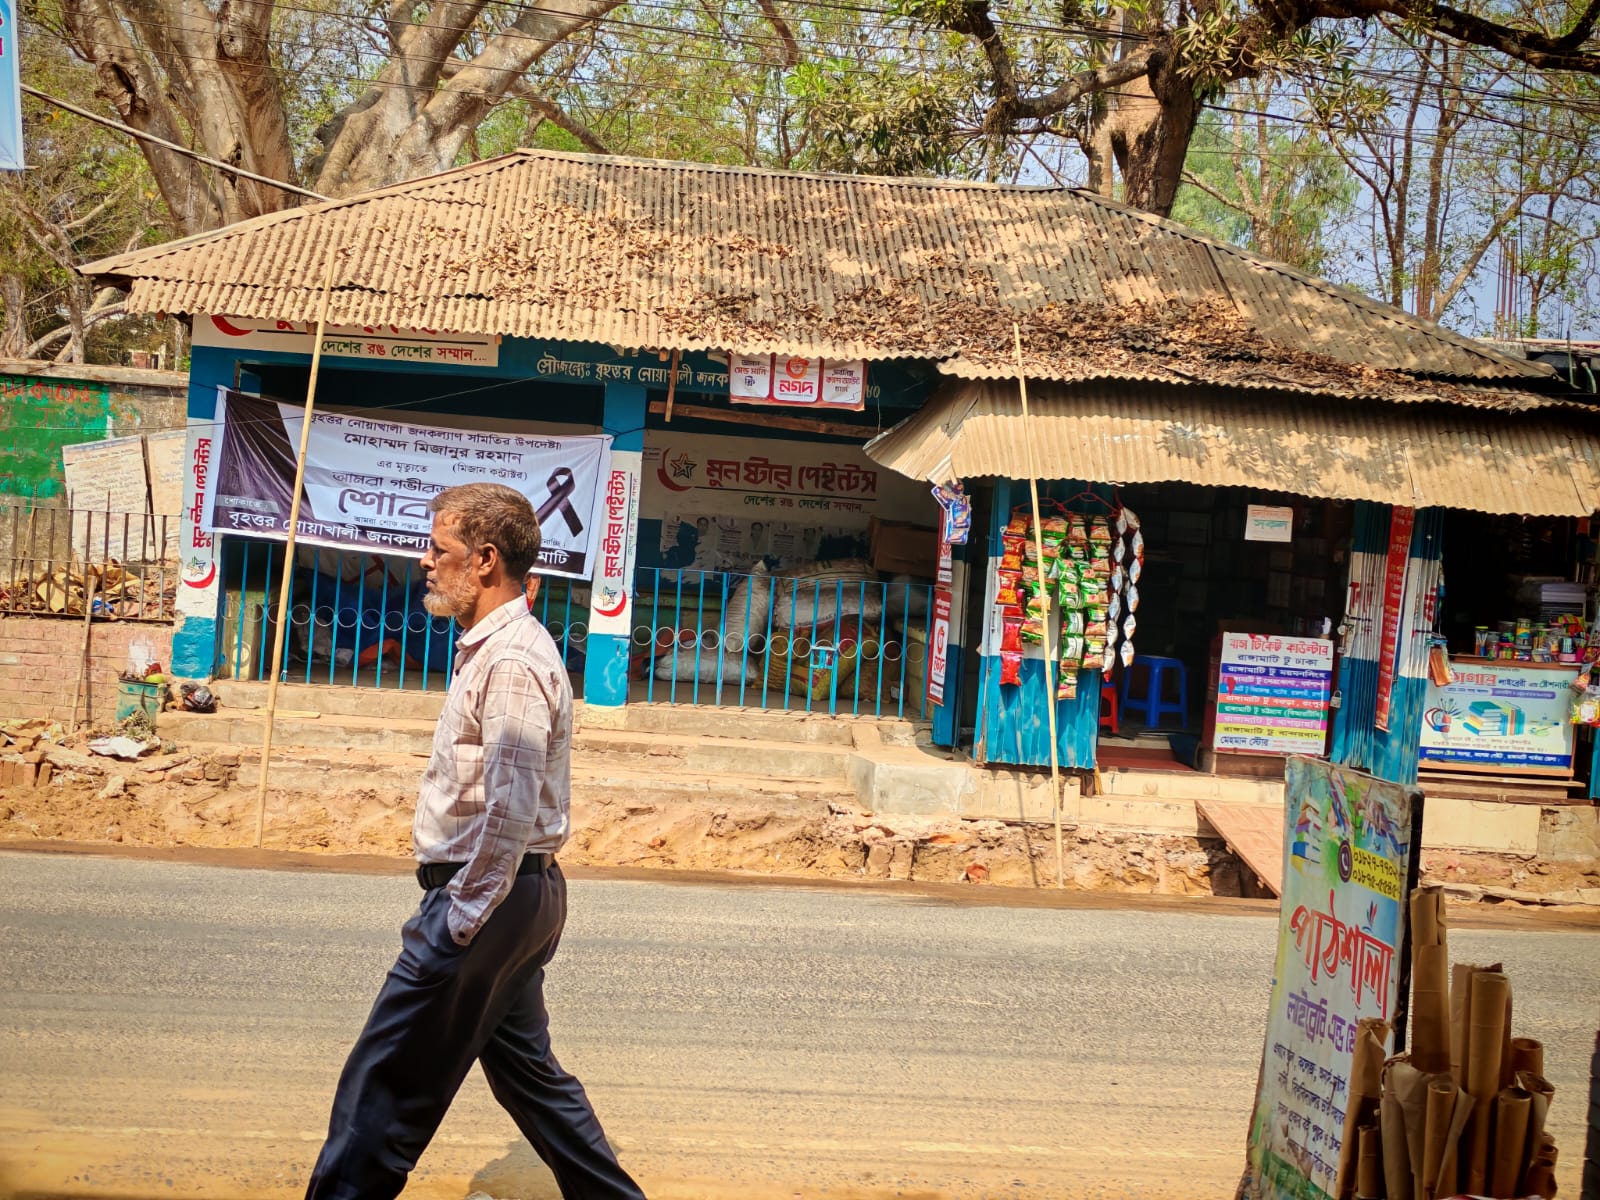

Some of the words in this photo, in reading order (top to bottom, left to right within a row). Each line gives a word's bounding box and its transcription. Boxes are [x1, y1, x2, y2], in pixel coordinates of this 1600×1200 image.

[321, 340, 361, 356] দেশের
[367, 343, 386, 357] রঙ
[391, 344, 432, 360] দেশের
[638, 363, 693, 385] নোয়াালী
[779, 379, 814, 395] নগদ
[347, 418, 403, 436] নোয়াখালী
[407, 426, 462, 442] জনকল্যাণ
[467, 432, 511, 446] সমিতির
[514, 436, 562, 450] উপদেষ্টা
[344, 432, 409, 452] মোহাম্মদ
[414, 440, 469, 460] মিজানুর
[475, 449, 524, 465] রহমান
[376, 460, 393, 469] এর
[452, 462, 486, 474] (মিজান
[706, 458, 741, 487] মুন
[798, 463, 878, 493] পেইন্টস
[332, 471, 384, 487] আমরা
[390, 477, 449, 494] গভীর
[338, 487, 431, 521] শোক
[606, 470, 626, 521] পেইন্টস
[743, 494, 776, 507] দেশের
[779, 497, 794, 508] রঙ
[798, 499, 830, 511] দেশের
[192, 527, 212, 548] মুন
[228, 510, 277, 529] বৃহত্তর
[283, 517, 359, 541] োয়াখালী
[366, 529, 431, 550] জনকল্যা
[537, 549, 570, 565] মাটি
[605, 556, 624, 578] মুন
[1229, 638, 1248, 650] বাস
[1251, 637, 1282, 652] টিকেট
[1286, 641, 1329, 656] কাউন্টার
[1290, 888, 1396, 1022] পাঠশালা
